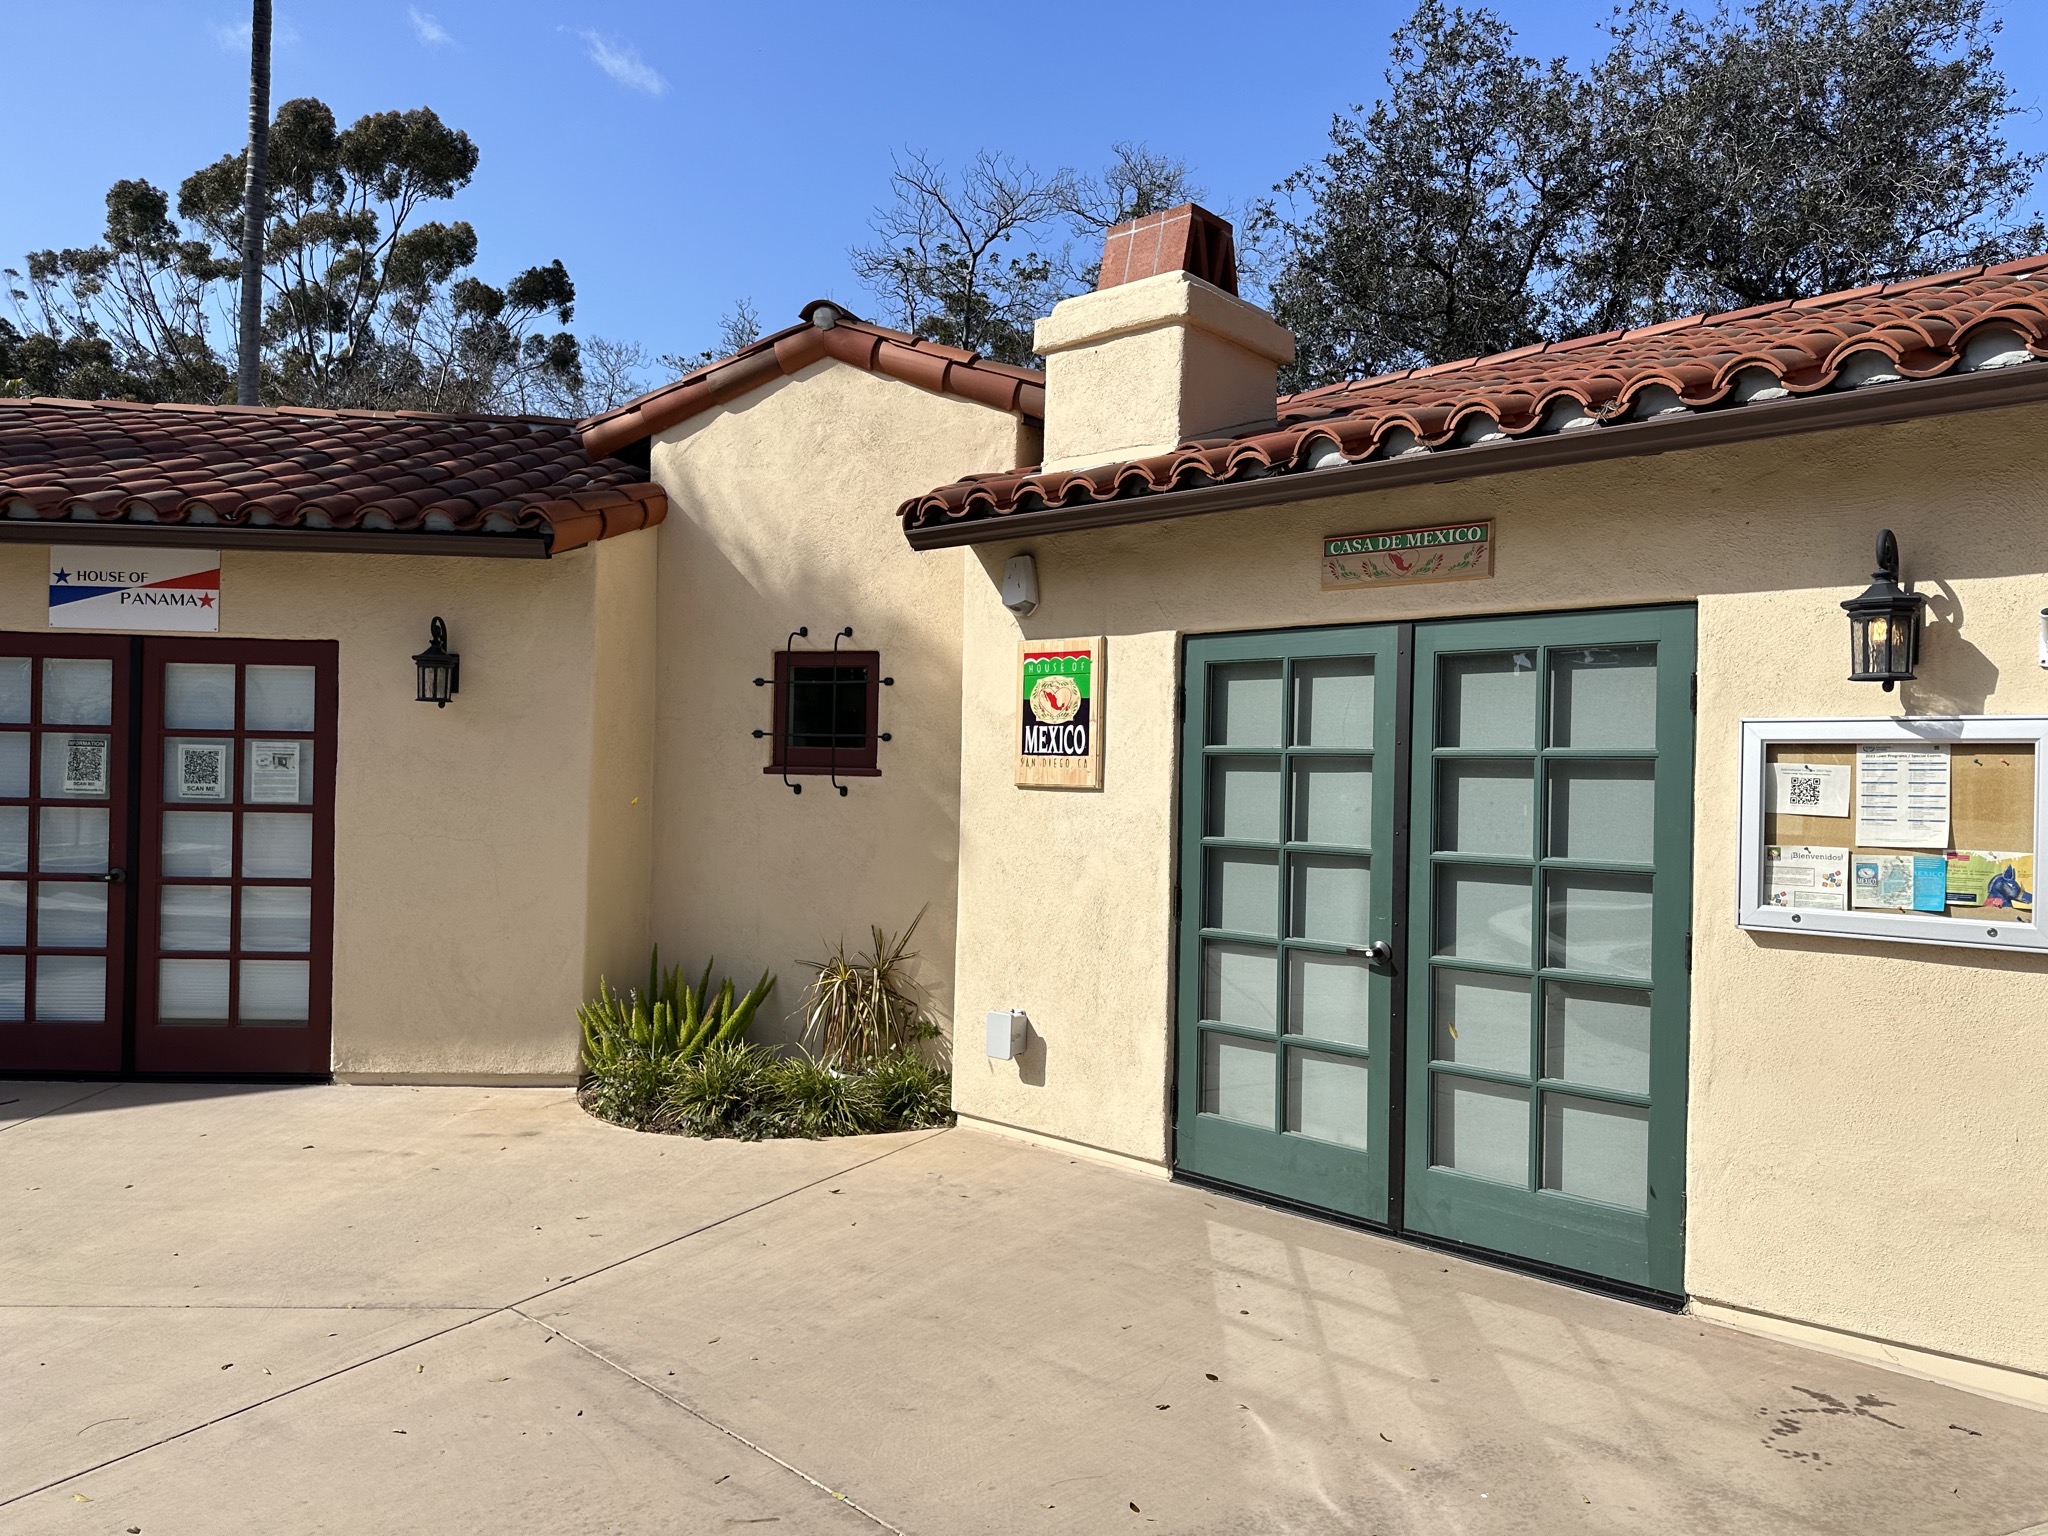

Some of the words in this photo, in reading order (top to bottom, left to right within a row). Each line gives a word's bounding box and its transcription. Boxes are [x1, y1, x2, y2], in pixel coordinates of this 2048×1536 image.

[1330, 539, 1374, 555] CASA
[1378, 536, 1402, 549] DE
[1407, 526, 1481, 547] MEXICO
[77, 570, 126, 583] HOUSE
[129, 572, 149, 583] OF
[120, 592, 198, 606] PANAMA
[1028, 663, 1065, 673] HOUSE
[1071, 662, 1085, 672] OF
[1024, 724, 1086, 755] MEXICO
[1020, 758, 1036, 768] SAN
[1077, 758, 1088, 768] CA
